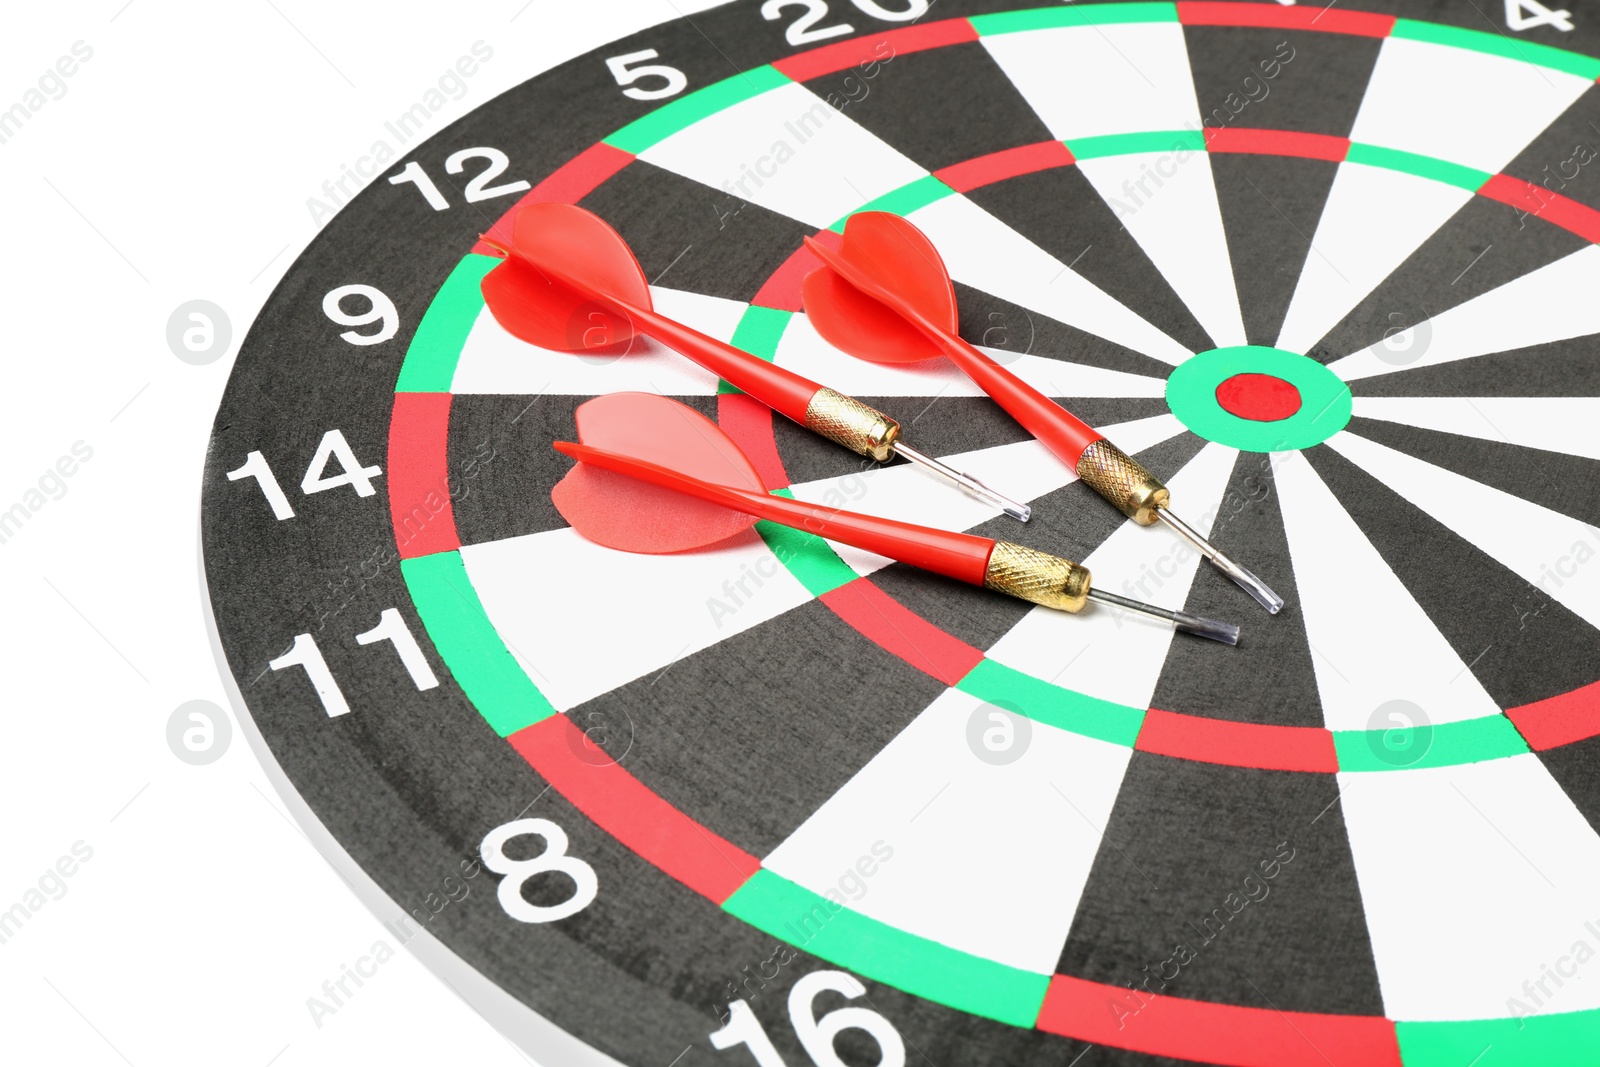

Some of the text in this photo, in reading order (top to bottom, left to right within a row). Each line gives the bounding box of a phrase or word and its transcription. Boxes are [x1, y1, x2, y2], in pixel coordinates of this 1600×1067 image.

[605, 48, 688, 101] 5
[387, 146, 532, 212] 12
[322, 283, 400, 346] 9
[226, 428, 383, 521] 14
[268, 607, 440, 719] 11
[479, 817, 599, 924] 8
[708, 969, 906, 1067] 16
